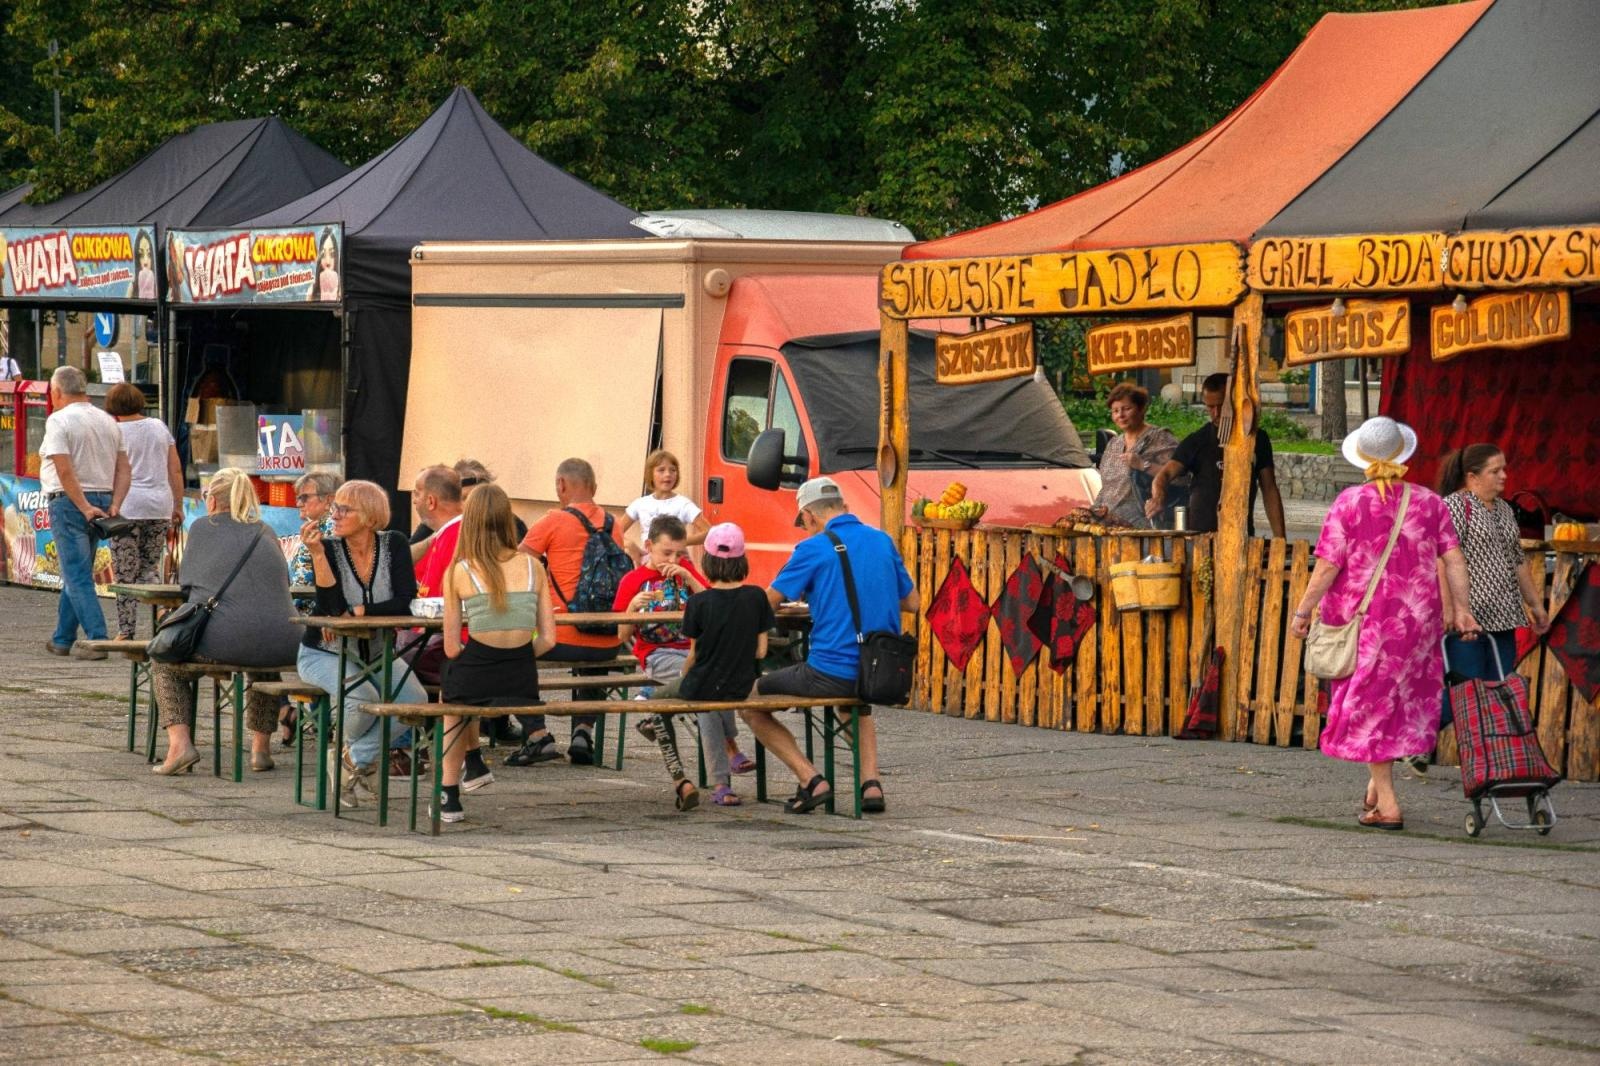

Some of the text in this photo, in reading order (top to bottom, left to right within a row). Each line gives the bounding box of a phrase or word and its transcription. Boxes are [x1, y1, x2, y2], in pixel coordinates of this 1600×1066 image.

[7, 231, 78, 294] WATA
[72, 234, 133, 261] CUKROWA
[185, 234, 255, 300] WATA
[252, 234, 317, 262] CUKROWA
[1059, 249, 1201, 309] JADŁO
[1450, 234, 1556, 283] CHUDY
[1091, 325, 1190, 365] KIEŁBASA
[1303, 311, 1384, 354] BIGOS
[258, 456, 304, 470] UKROW
